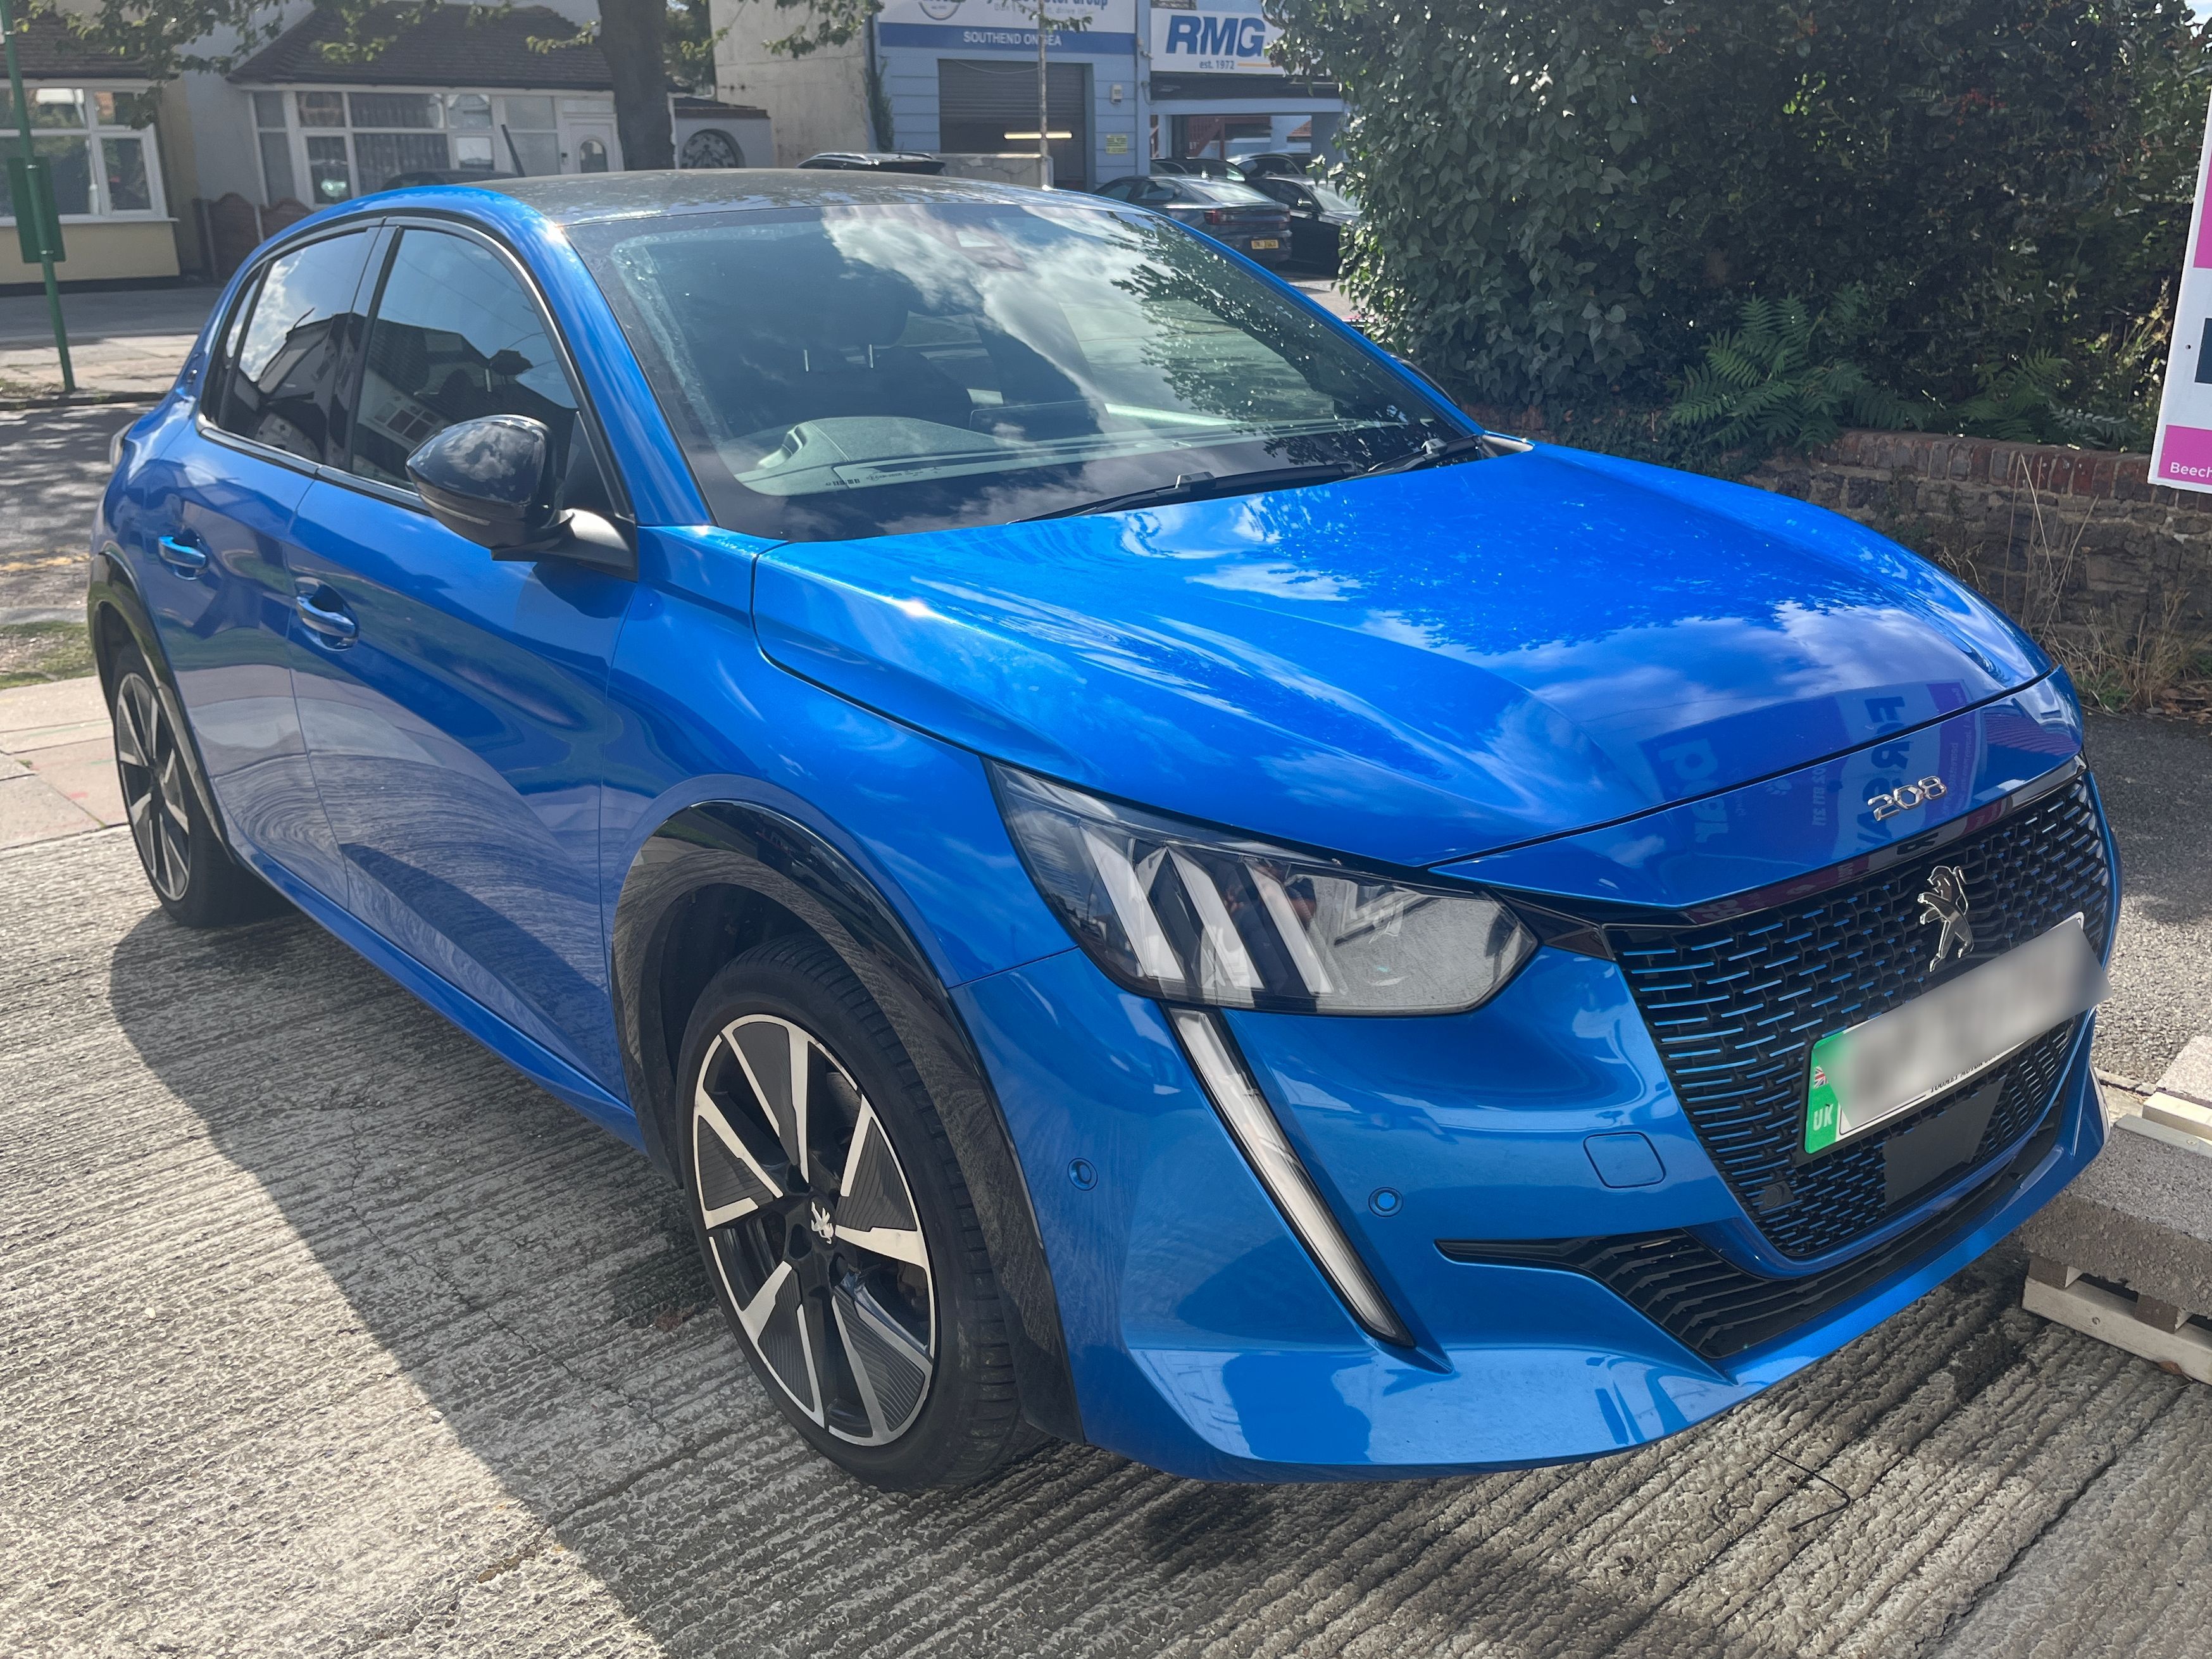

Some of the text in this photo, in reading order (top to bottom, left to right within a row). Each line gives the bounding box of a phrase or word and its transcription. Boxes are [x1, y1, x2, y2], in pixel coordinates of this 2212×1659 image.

[963, 31, 1022, 44] SOUTHEND
[1166, 15, 1265, 58] RMG
[1216, 61, 1234, 70] 1972
[1867, 775, 1947, 822] 208
[1813, 1103, 1834, 1131] UK
